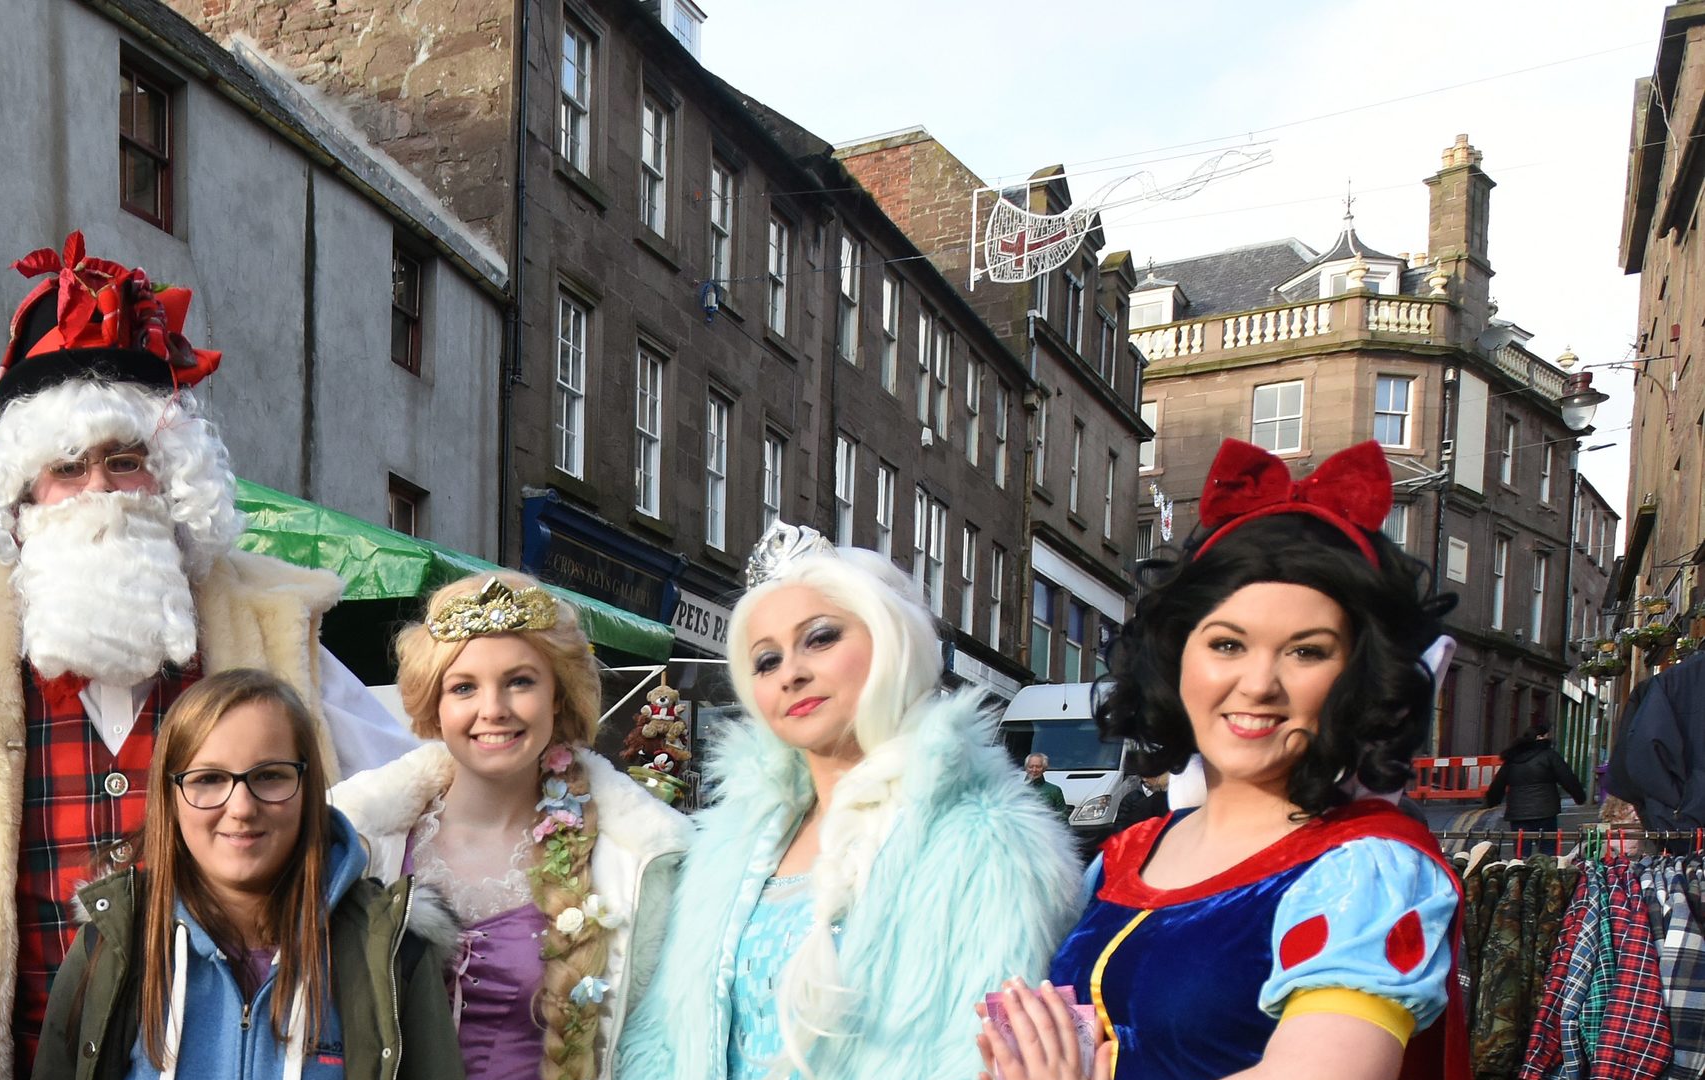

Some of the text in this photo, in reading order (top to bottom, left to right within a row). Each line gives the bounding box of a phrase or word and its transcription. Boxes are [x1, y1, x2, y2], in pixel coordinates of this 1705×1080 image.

[553, 553, 585, 579] CROSS
[586, 567, 611, 592] KEYS
[612, 578, 650, 607] GALLERY
[676, 600, 711, 636] PETS
